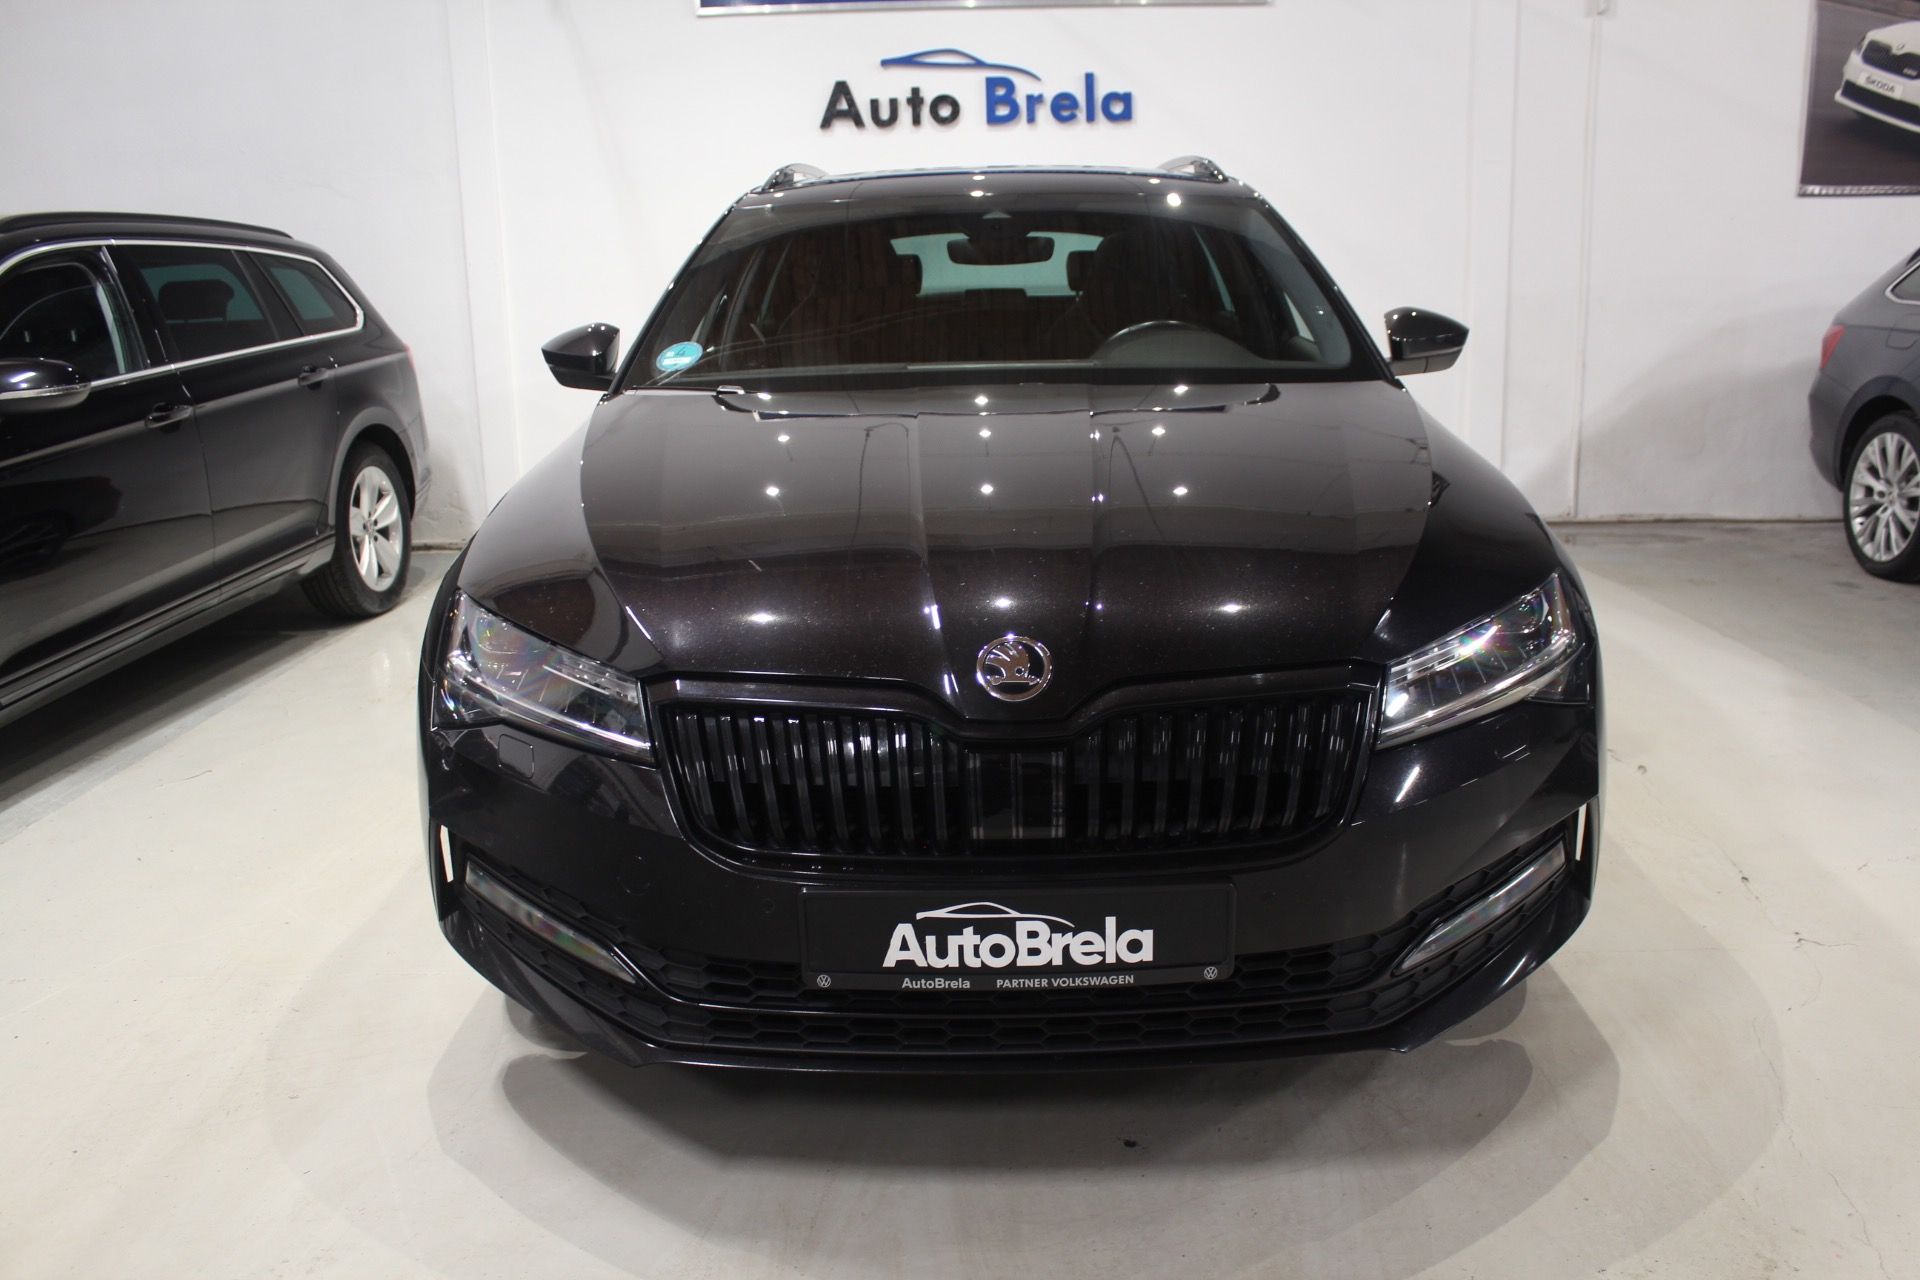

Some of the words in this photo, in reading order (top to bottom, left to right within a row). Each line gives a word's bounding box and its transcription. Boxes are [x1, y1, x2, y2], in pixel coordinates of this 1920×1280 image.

[820, 80, 961, 130] Auto
[985, 73, 1133, 126] Brela
[882, 916, 1154, 968] AutoBrela
[901, 977, 971, 989] AutoBrela
[996, 978, 1049, 989] PARTNER
[1051, 975, 1135, 988] VOLKSWAGEN
